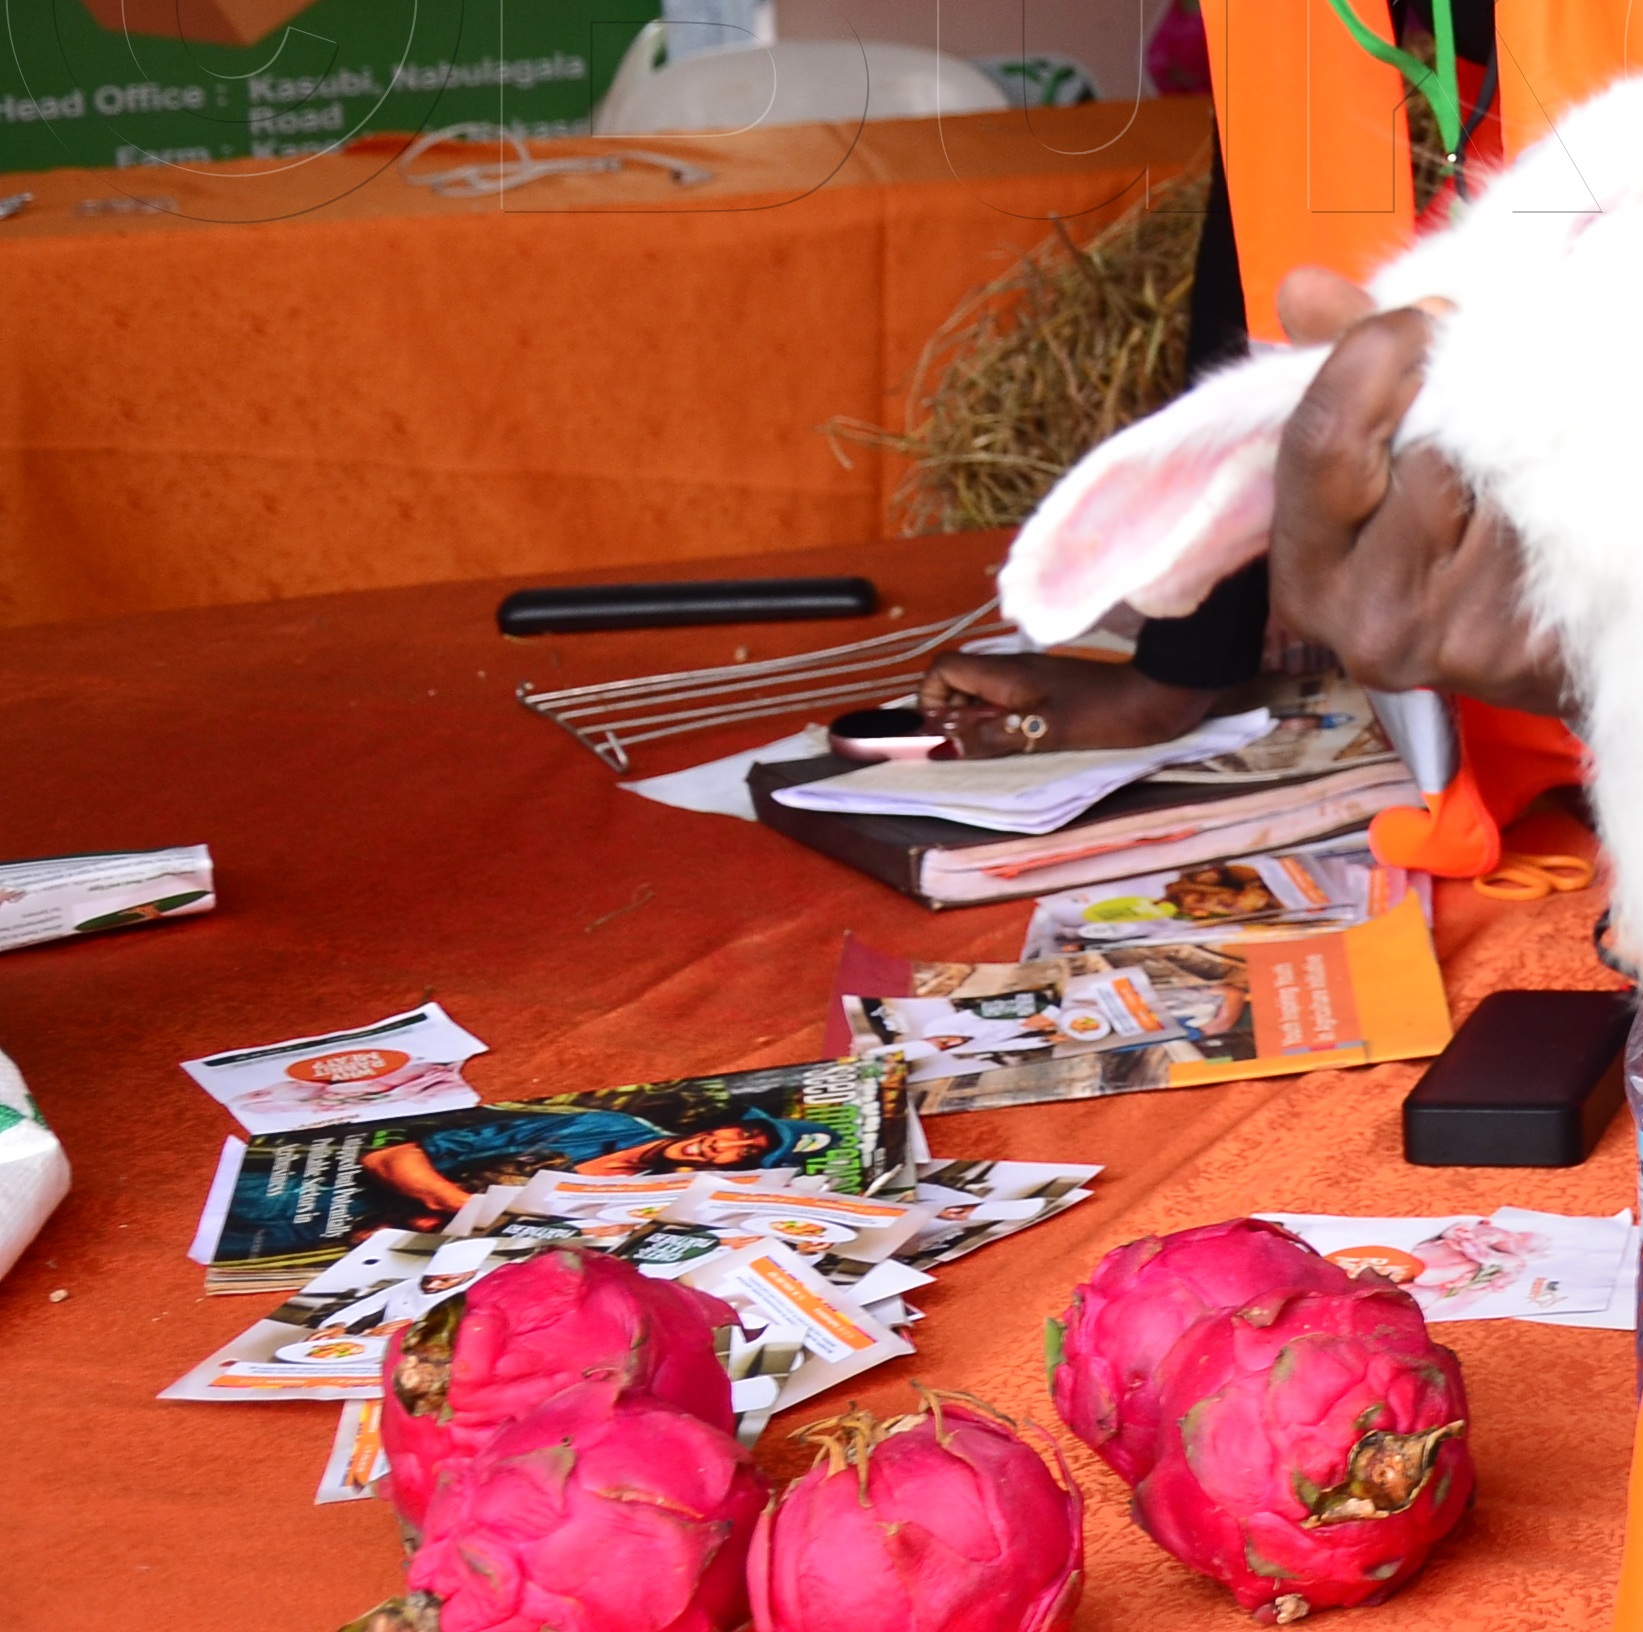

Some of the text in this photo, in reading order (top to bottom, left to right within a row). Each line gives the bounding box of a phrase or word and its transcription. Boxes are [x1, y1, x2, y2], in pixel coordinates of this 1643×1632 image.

[95, 83, 205, 119] Office
[249, 103, 344, 136] Road
[320, 1188, 363, 1238] Potentially
